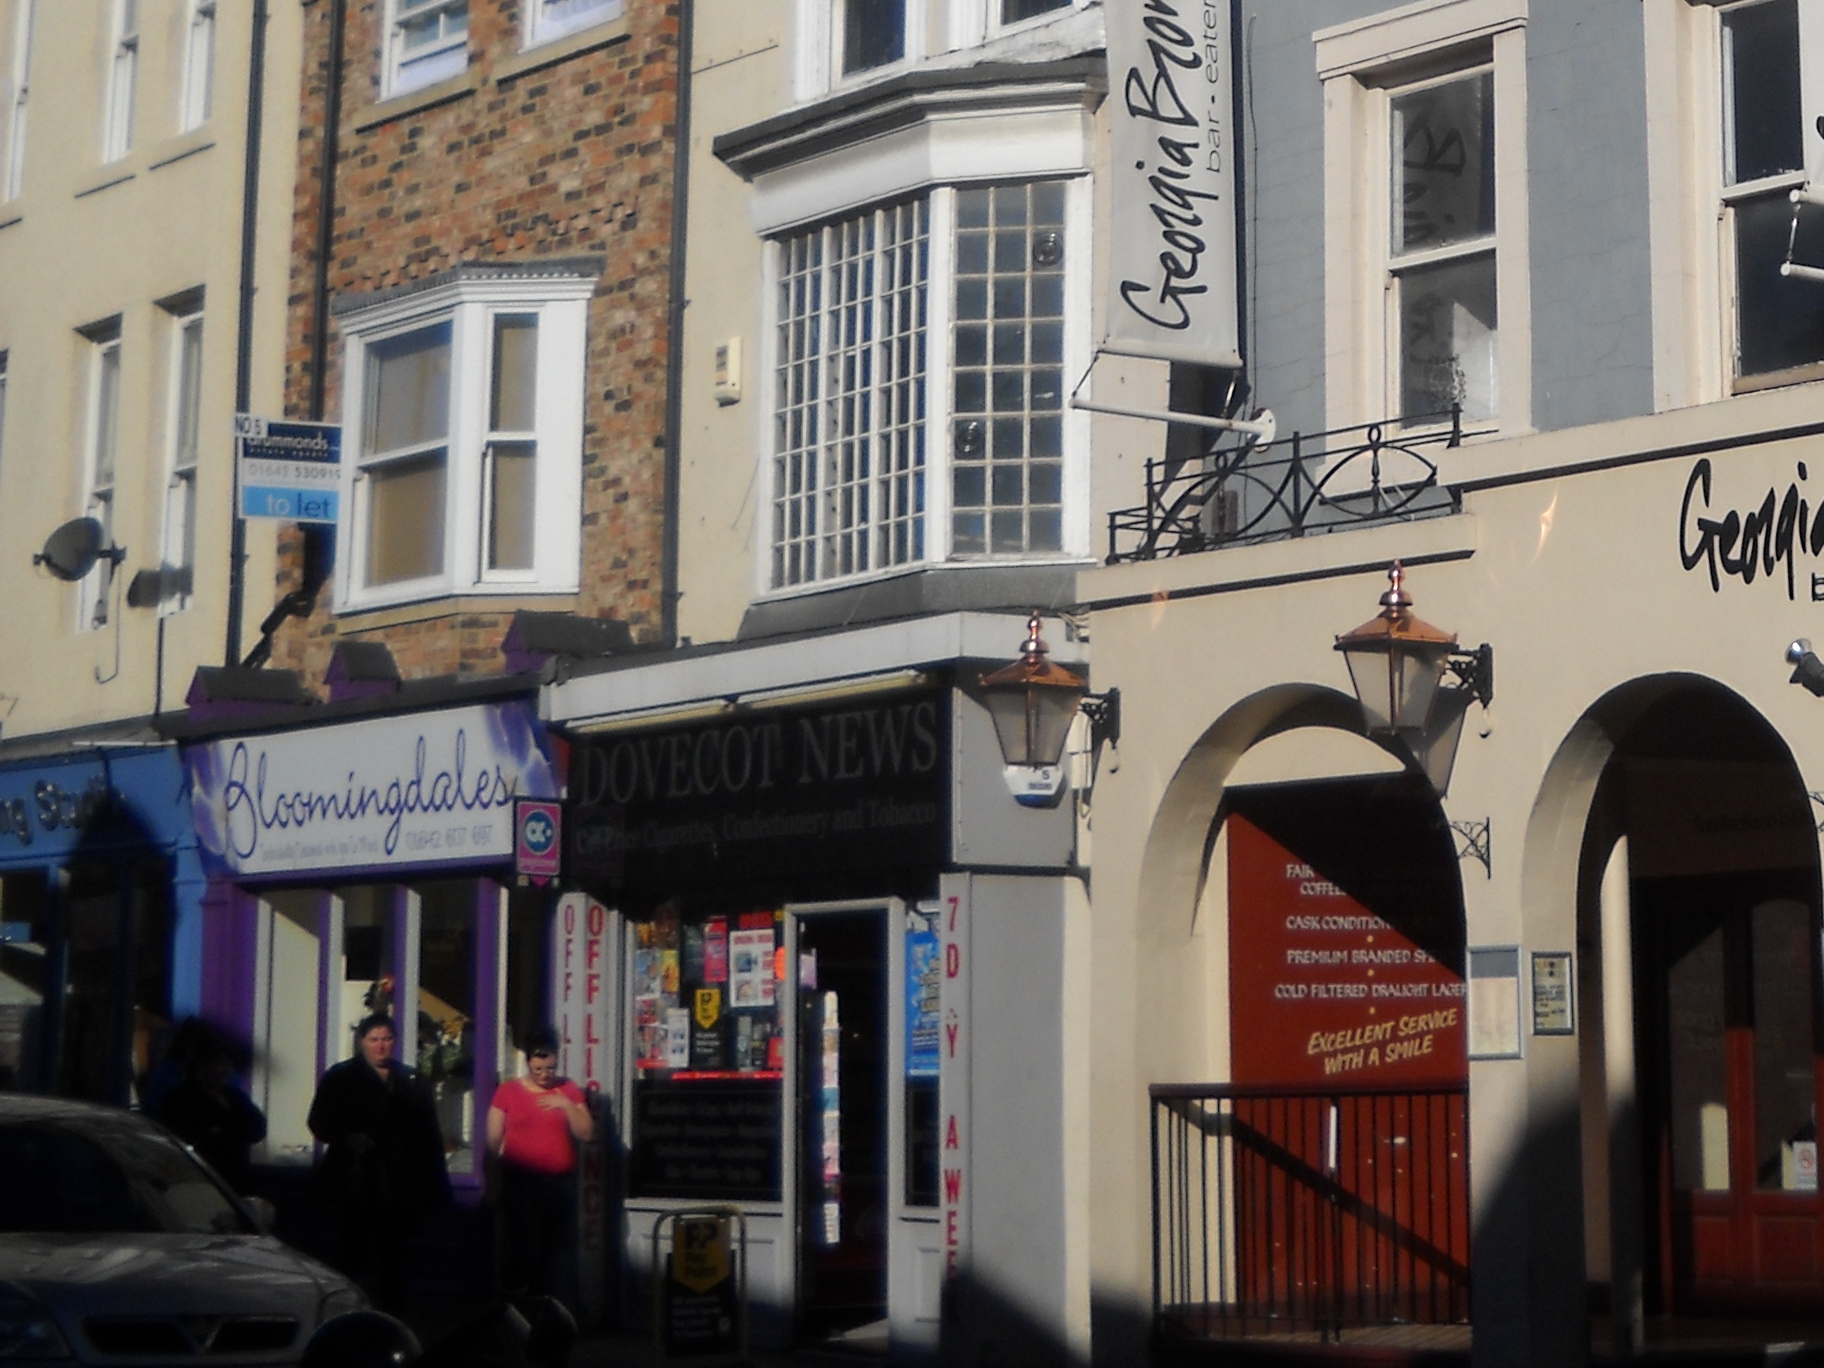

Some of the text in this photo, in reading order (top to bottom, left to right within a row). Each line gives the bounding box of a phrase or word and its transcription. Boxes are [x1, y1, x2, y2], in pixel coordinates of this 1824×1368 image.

[1206, 116, 1222, 174] bar
[1119, 134, 1219, 331] Georgia
[265, 491, 331, 518] to let
[578, 701, 940, 808] DOVECOT NEWS
[223, 727, 518, 859] Bloomingdales
[1300, 880, 1347, 896] COFFE
[1286, 915, 1321, 930] CASK
[564, 904, 576, 1003] OFF
[1286, 949, 1348, 965] PREMIUM
[1352, 949, 1411, 964] BRANDED
[1275, 983, 1307, 999] COLD
[1310, 983, 1368, 999] FILTERED
[1371, 982, 1429, 997] DRAUGHT
[1307, 1007, 1459, 1055] EXCELLENT SERVICE
[1324, 1034, 1435, 1075] WITH A SMILE
[584, 904, 605, 1252] OFF LICNCE
[943, 895, 963, 1300] 7 DY A WEE
